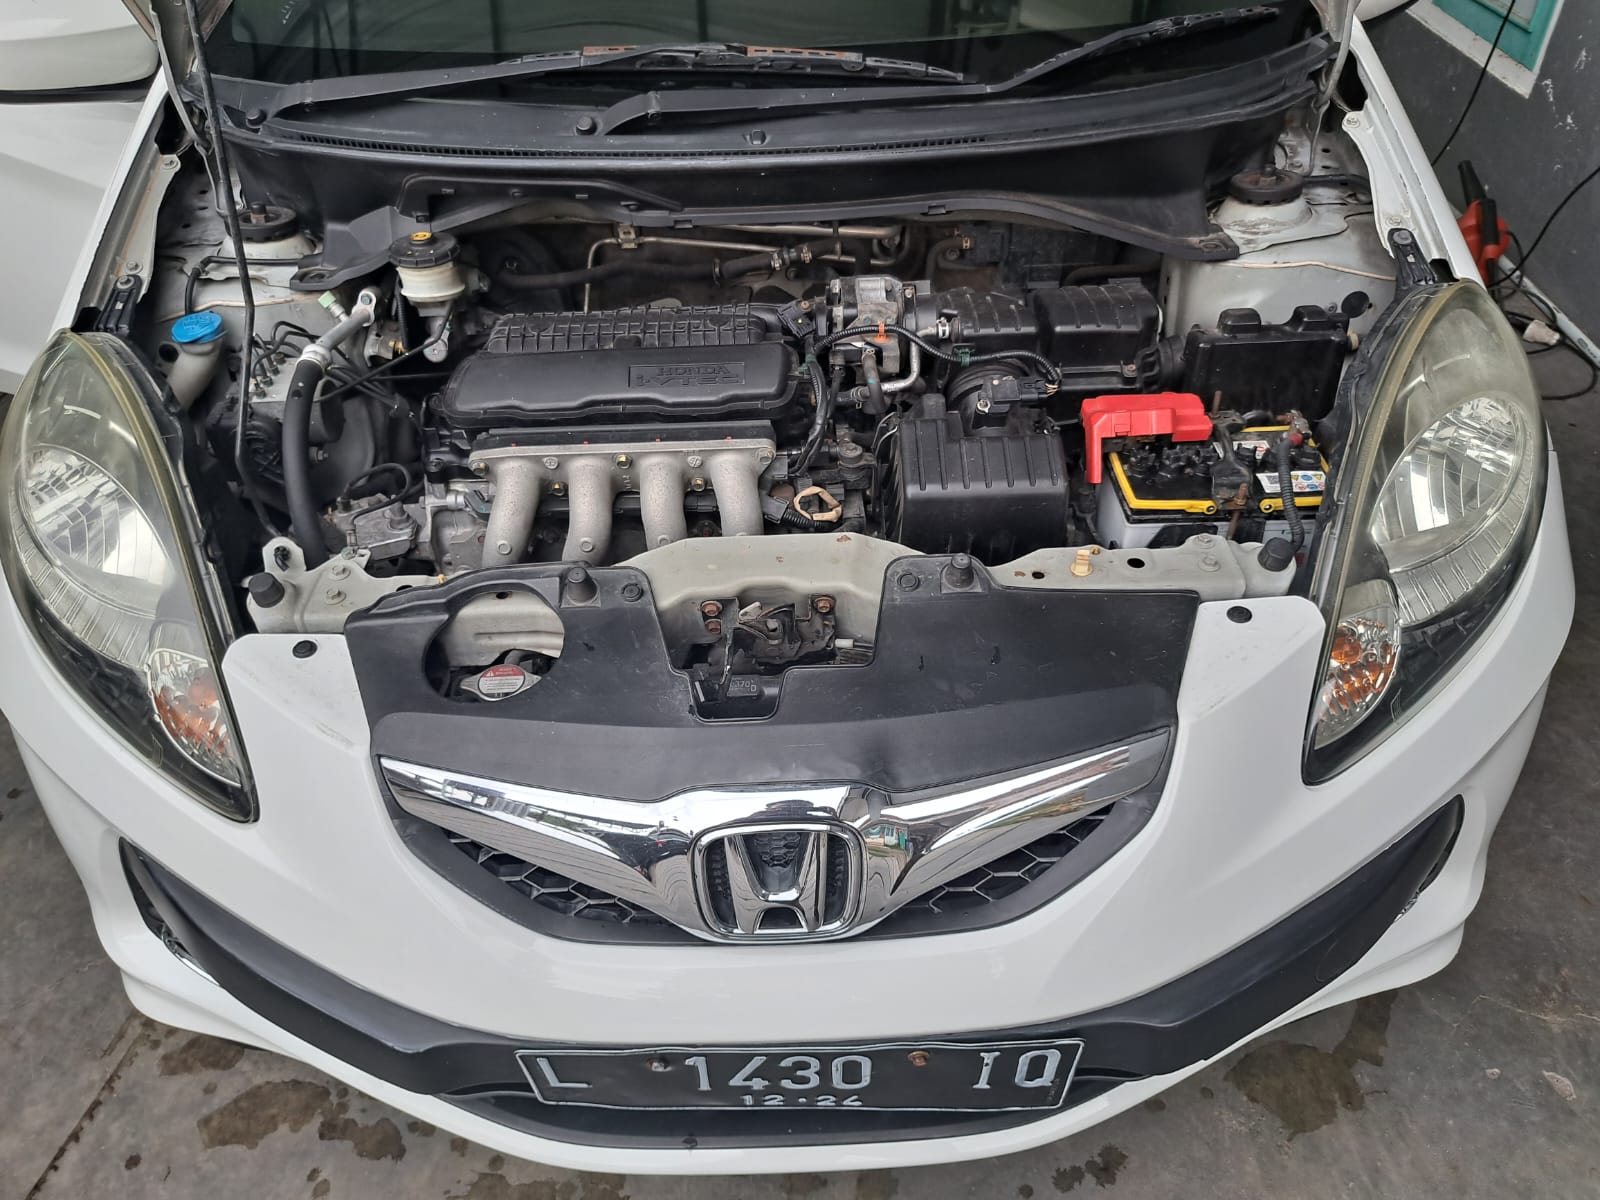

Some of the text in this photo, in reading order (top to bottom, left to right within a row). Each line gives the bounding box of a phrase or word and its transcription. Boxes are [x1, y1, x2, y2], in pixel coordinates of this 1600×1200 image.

[657, 366, 731, 377] HONDA
[536, 1057, 593, 1088] L
[684, 1055, 872, 1091] 1430
